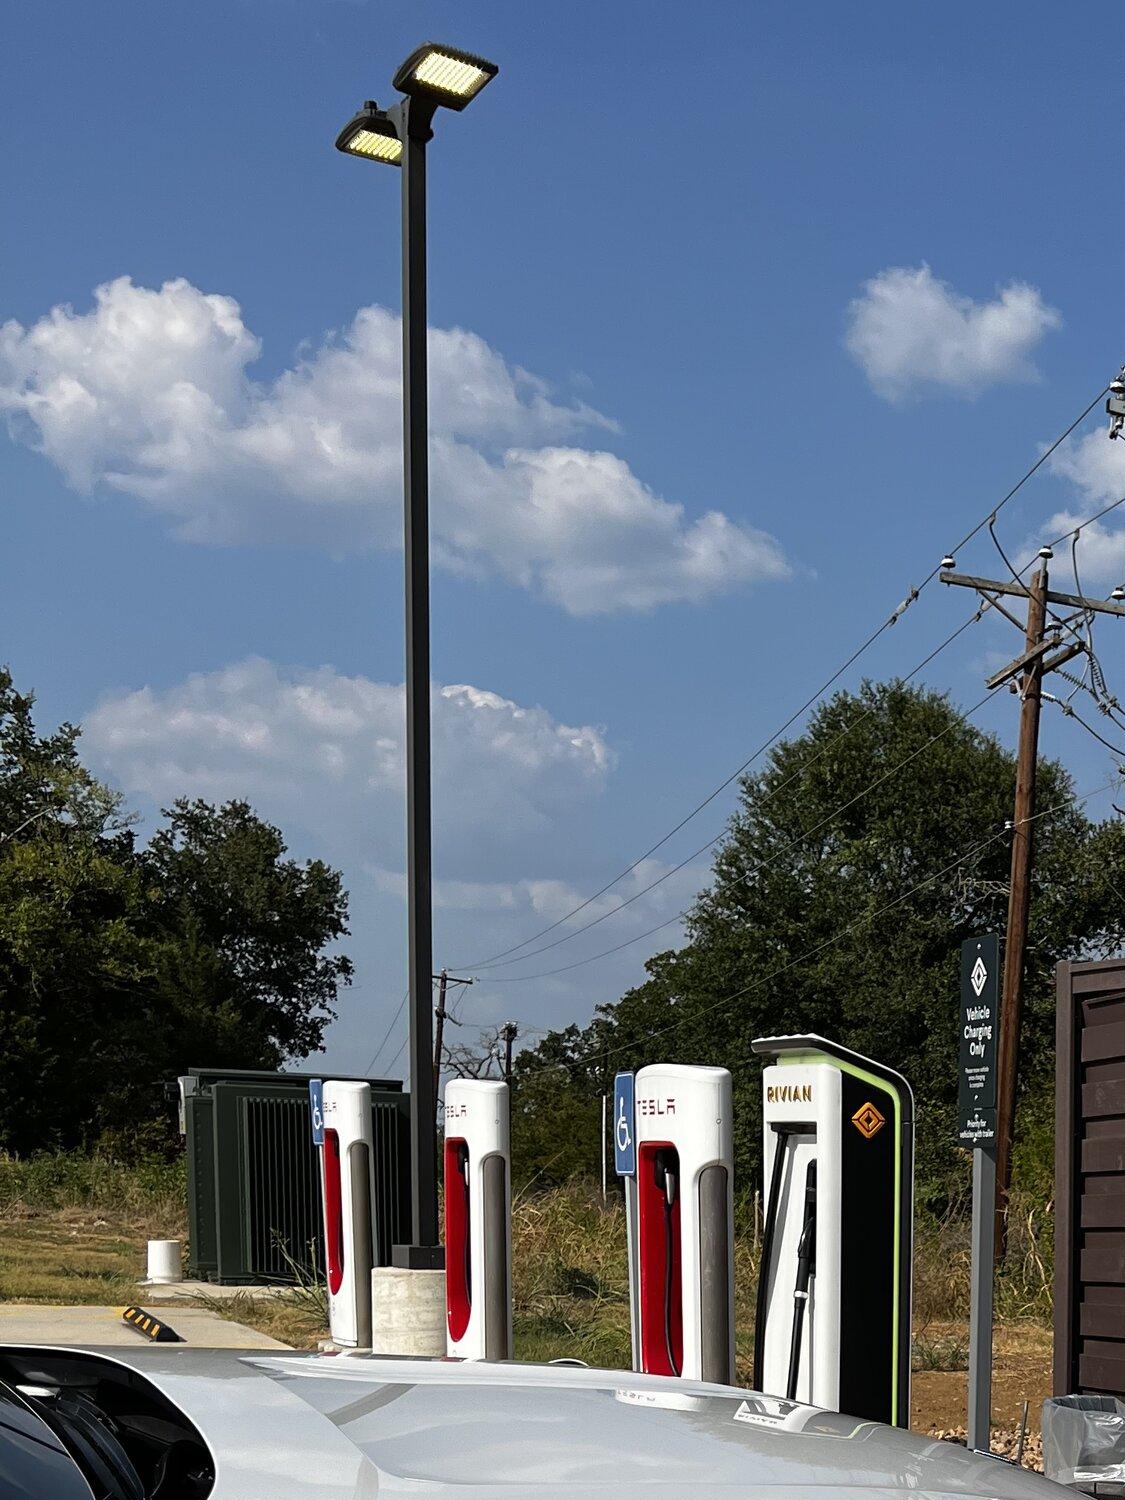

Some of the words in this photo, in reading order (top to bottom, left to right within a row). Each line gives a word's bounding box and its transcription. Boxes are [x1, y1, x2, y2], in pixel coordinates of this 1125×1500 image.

[966, 1005, 990, 1022] Vehicle
[963, 1023, 992, 1041] Charging
[969, 1041, 985, 1058] Only
[766, 1084, 812, 1104] RIVIAN
[445, 1104, 467, 1119] ESLA
